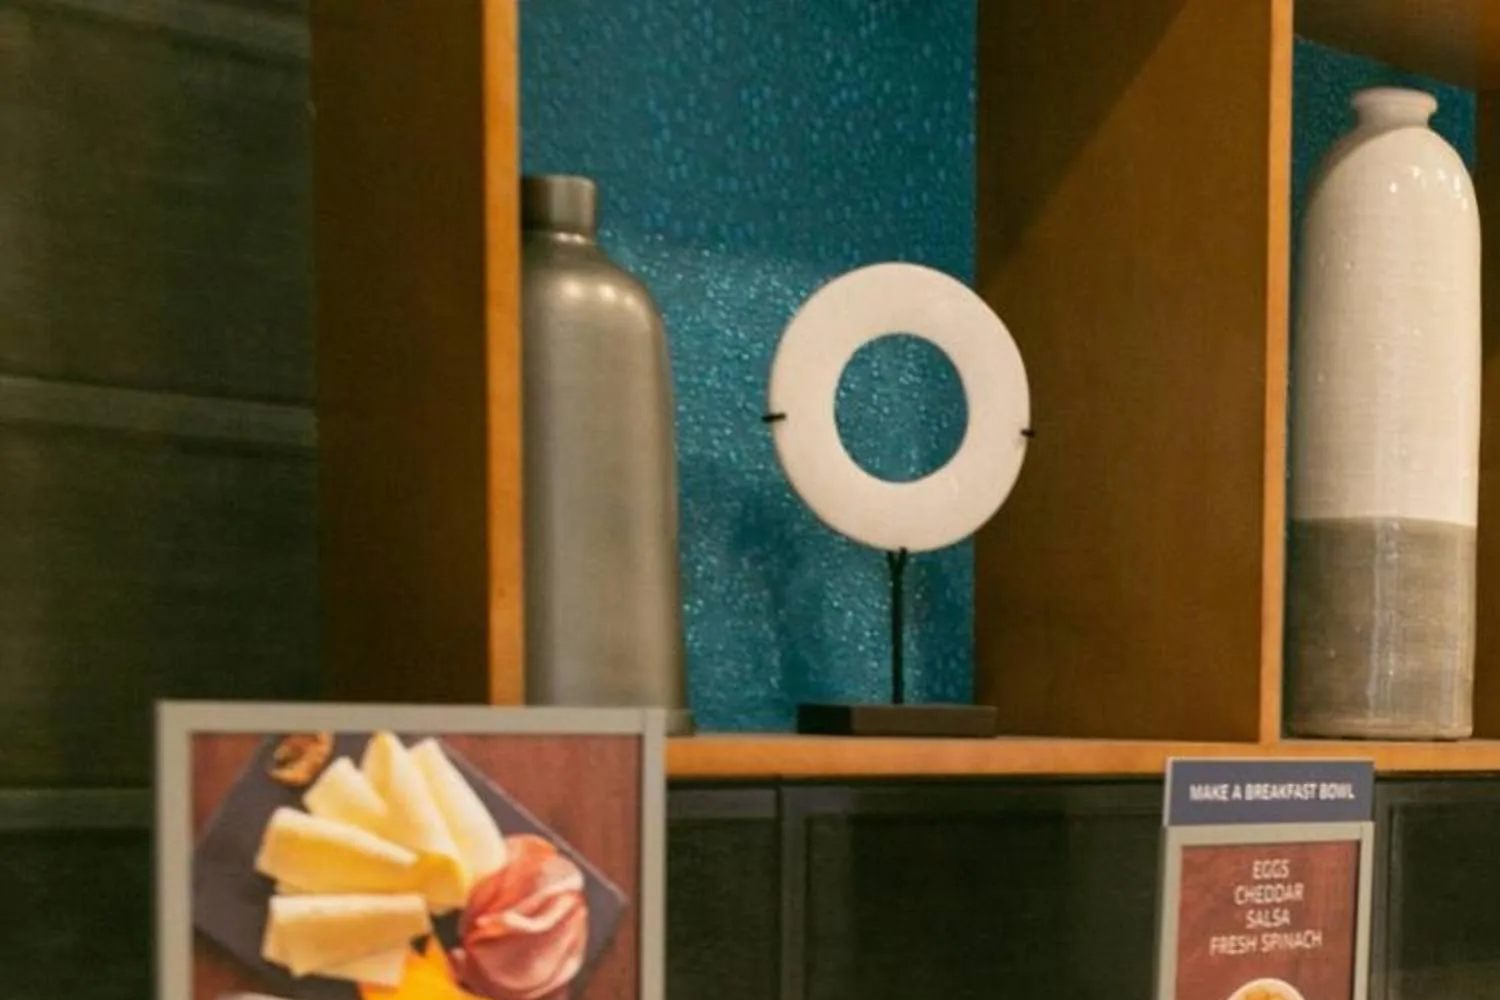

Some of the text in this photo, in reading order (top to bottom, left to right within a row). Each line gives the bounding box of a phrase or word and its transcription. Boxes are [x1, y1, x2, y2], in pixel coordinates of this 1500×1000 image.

[1189, 782, 1355, 801] MAKE A BREAKFAST BOWL
[1252, 859, 1290, 880] EGGS
[1234, 883, 1304, 905] CHEDDAR
[1246, 908, 1291, 929] SALSA
[1209, 929, 1323, 955] FRESH SPINACH
